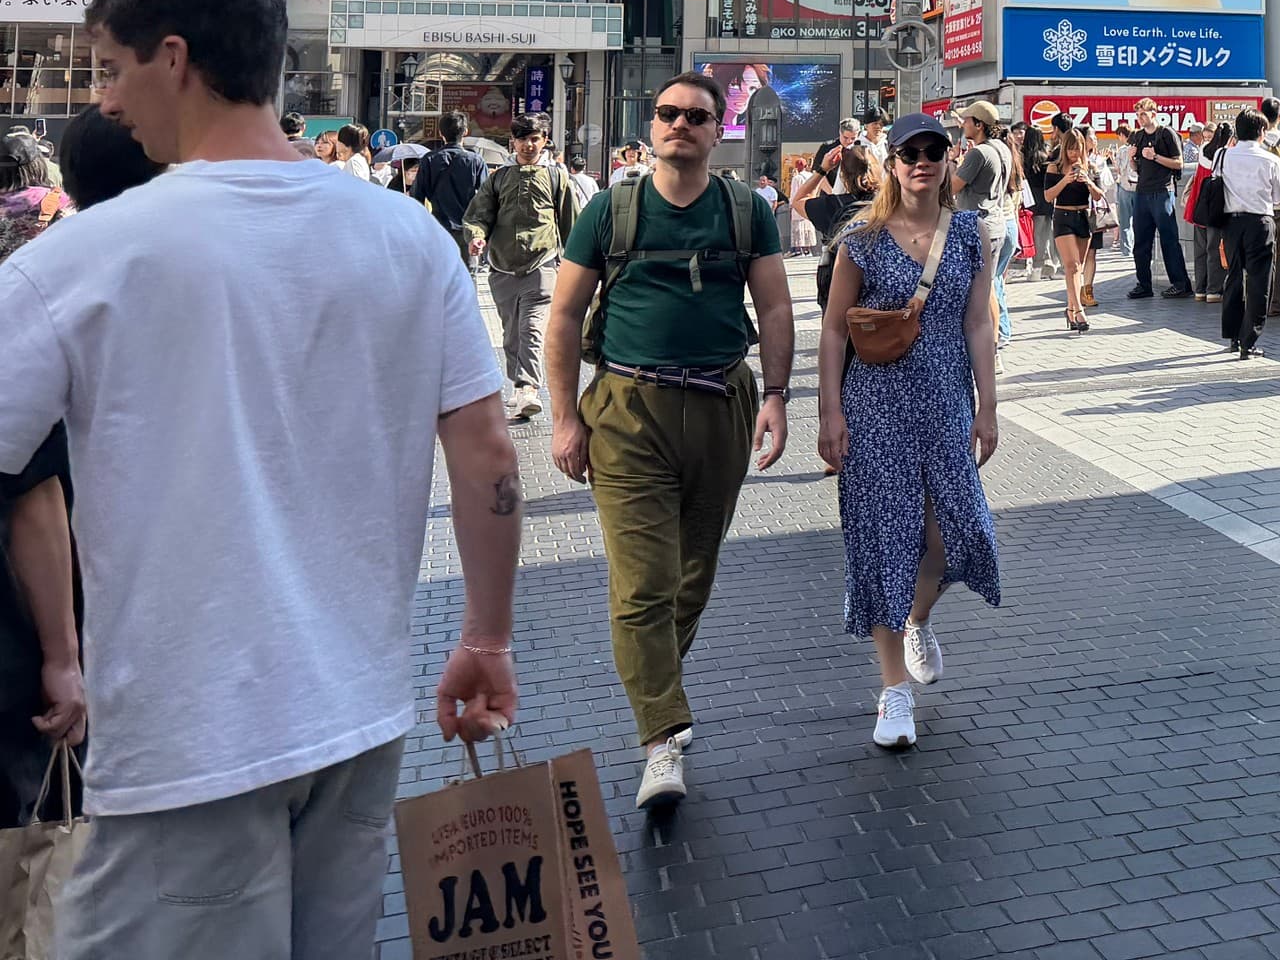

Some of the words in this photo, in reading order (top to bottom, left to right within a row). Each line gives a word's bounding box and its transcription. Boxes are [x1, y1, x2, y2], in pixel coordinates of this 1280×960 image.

[423, 31, 463, 43] EBISU
[1103, 25, 1130, 37] Love
[1132, 26, 1168, 38] Earth.
[1171, 27, 1197, 39] Love
[1199, 28, 1223, 39] Life.
[1096, 43, 1231, 69] 雪印メグミルク
[1068, 107, 1198, 132] ZETTRIA
[463, 807, 497, 830] EURO
[559, 780, 589, 851] HOPE
[500, 828, 539, 851] ITEMS
[573, 854, 601, 900] SEE
[428, 855, 548, 943] JAM
[584, 901, 613, 960] YOU
